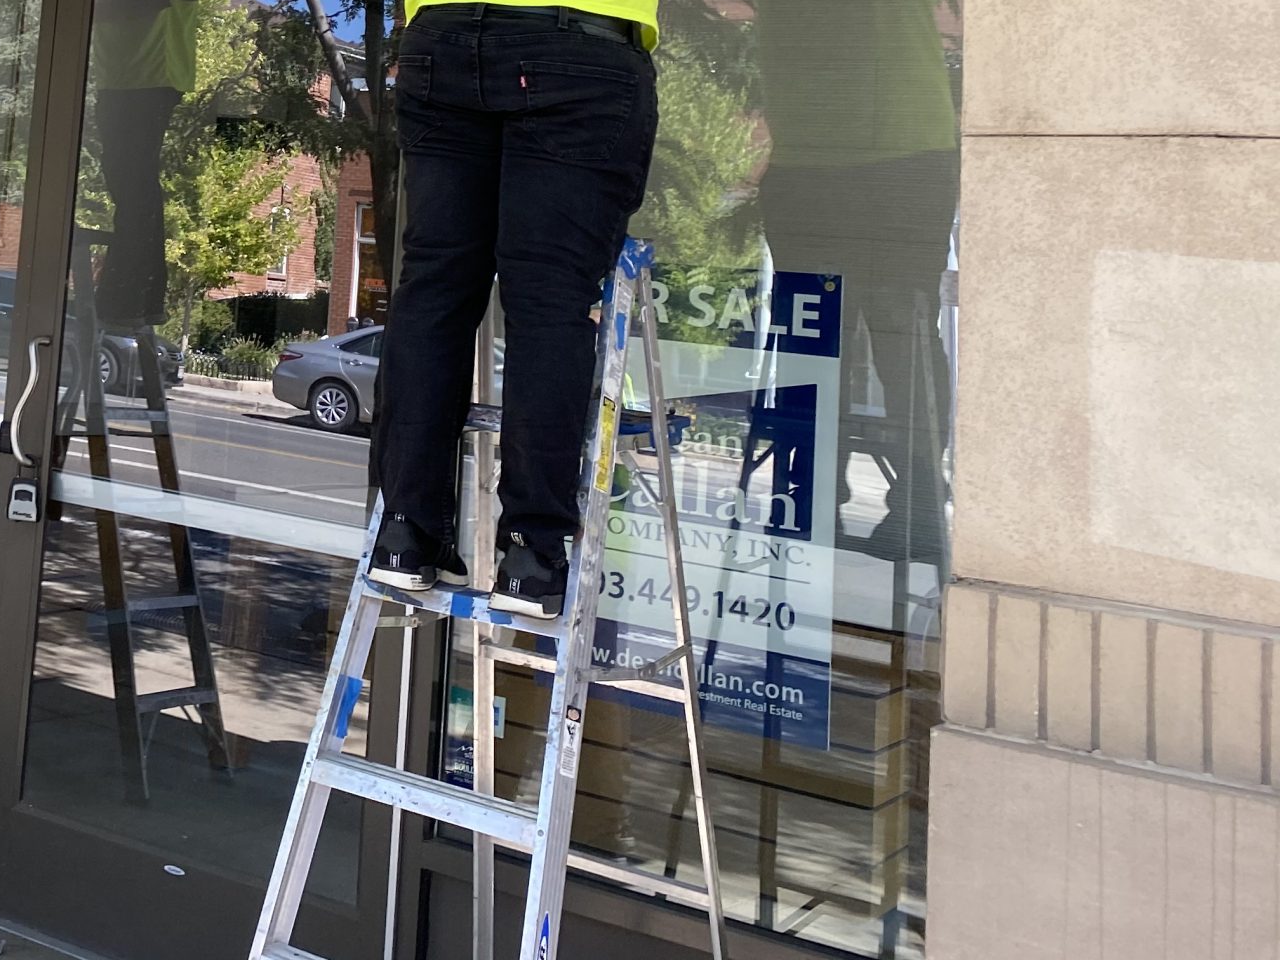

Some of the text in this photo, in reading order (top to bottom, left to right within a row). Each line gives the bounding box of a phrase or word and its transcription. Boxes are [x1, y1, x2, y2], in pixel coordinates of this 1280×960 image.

[687, 284, 821, 338] SALE
[610, 454, 801, 532] allan
[747, 538, 811, 567] INC.
[599, 571, 796, 631] 3.449.1420
[743, 698, 767, 713] Real
[769, 705, 803, 721] Estate
